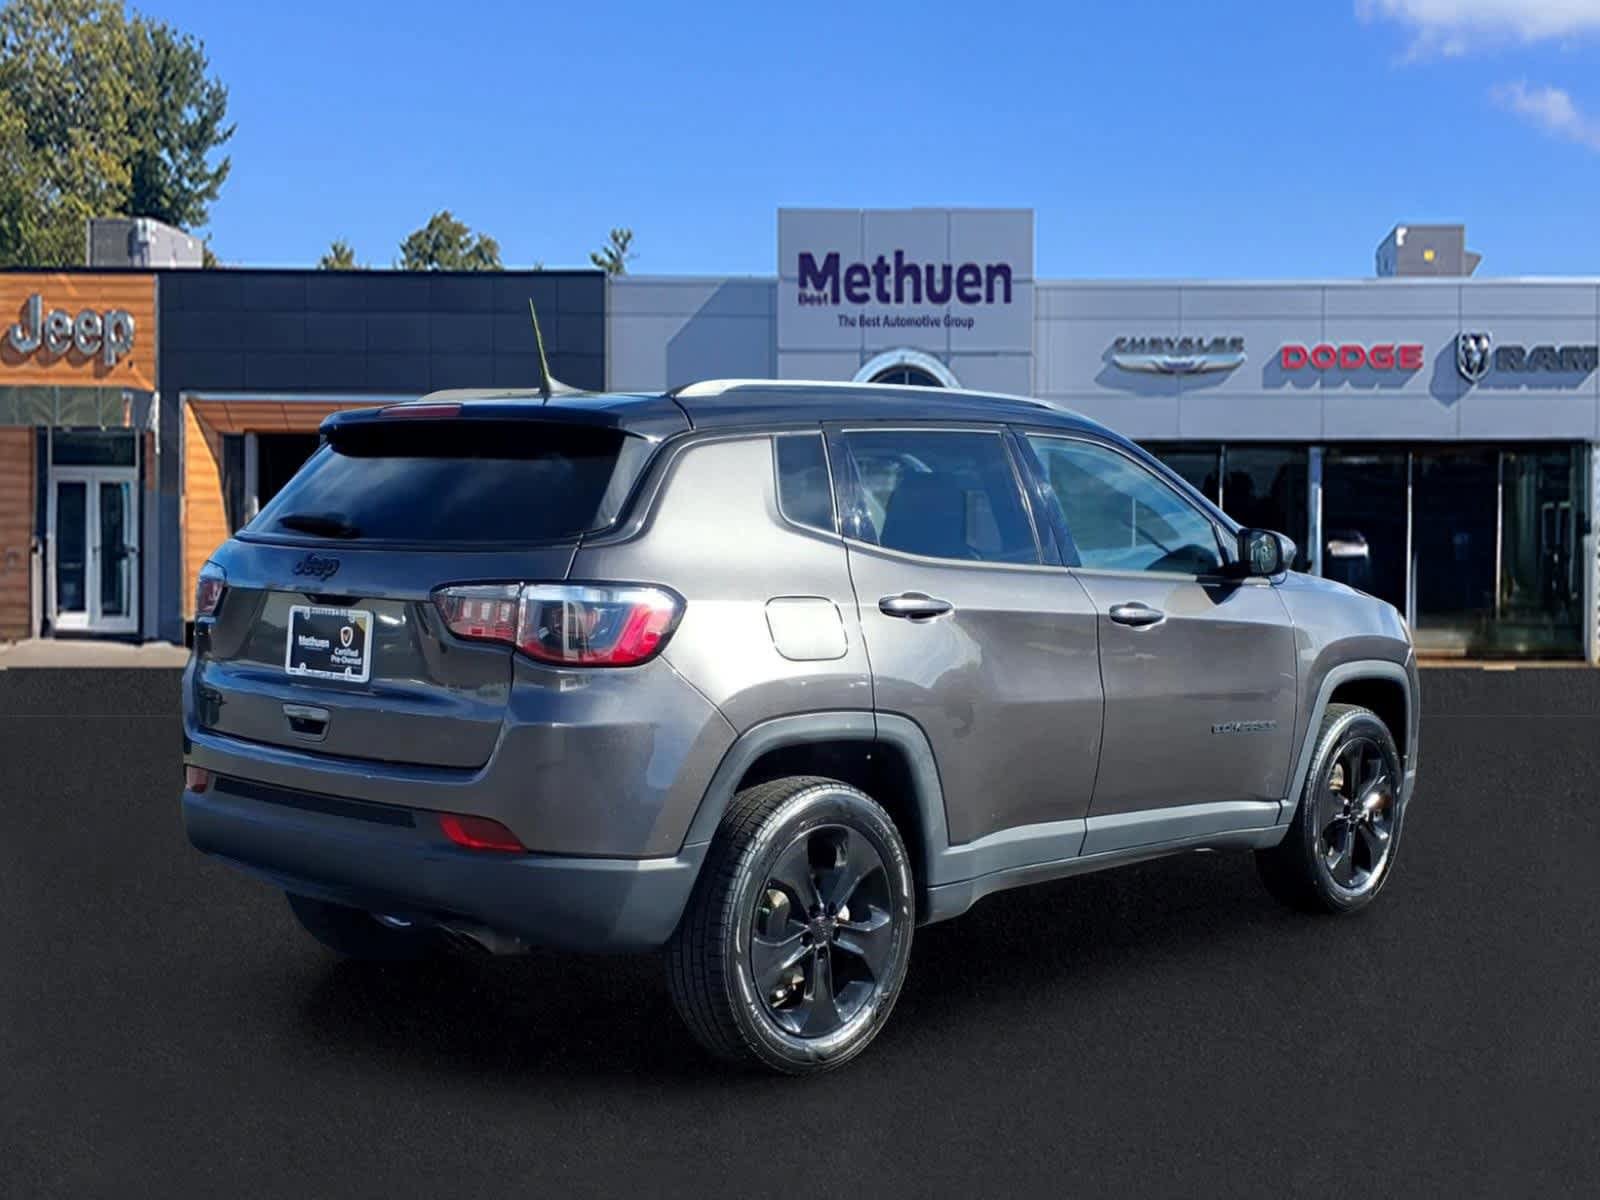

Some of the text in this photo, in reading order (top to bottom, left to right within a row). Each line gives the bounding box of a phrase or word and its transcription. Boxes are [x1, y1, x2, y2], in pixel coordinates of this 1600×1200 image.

[798, 249, 1012, 305] Methuen
[10, 293, 135, 367] Jeep
[838, 314, 975, 331] The Best Automotive Group
[1114, 335, 1245, 352] CHRYSLER
[1281, 344, 1424, 370] DODGE
[1495, 344, 1599, 372] RAM
[291, 552, 341, 582] Jeep
